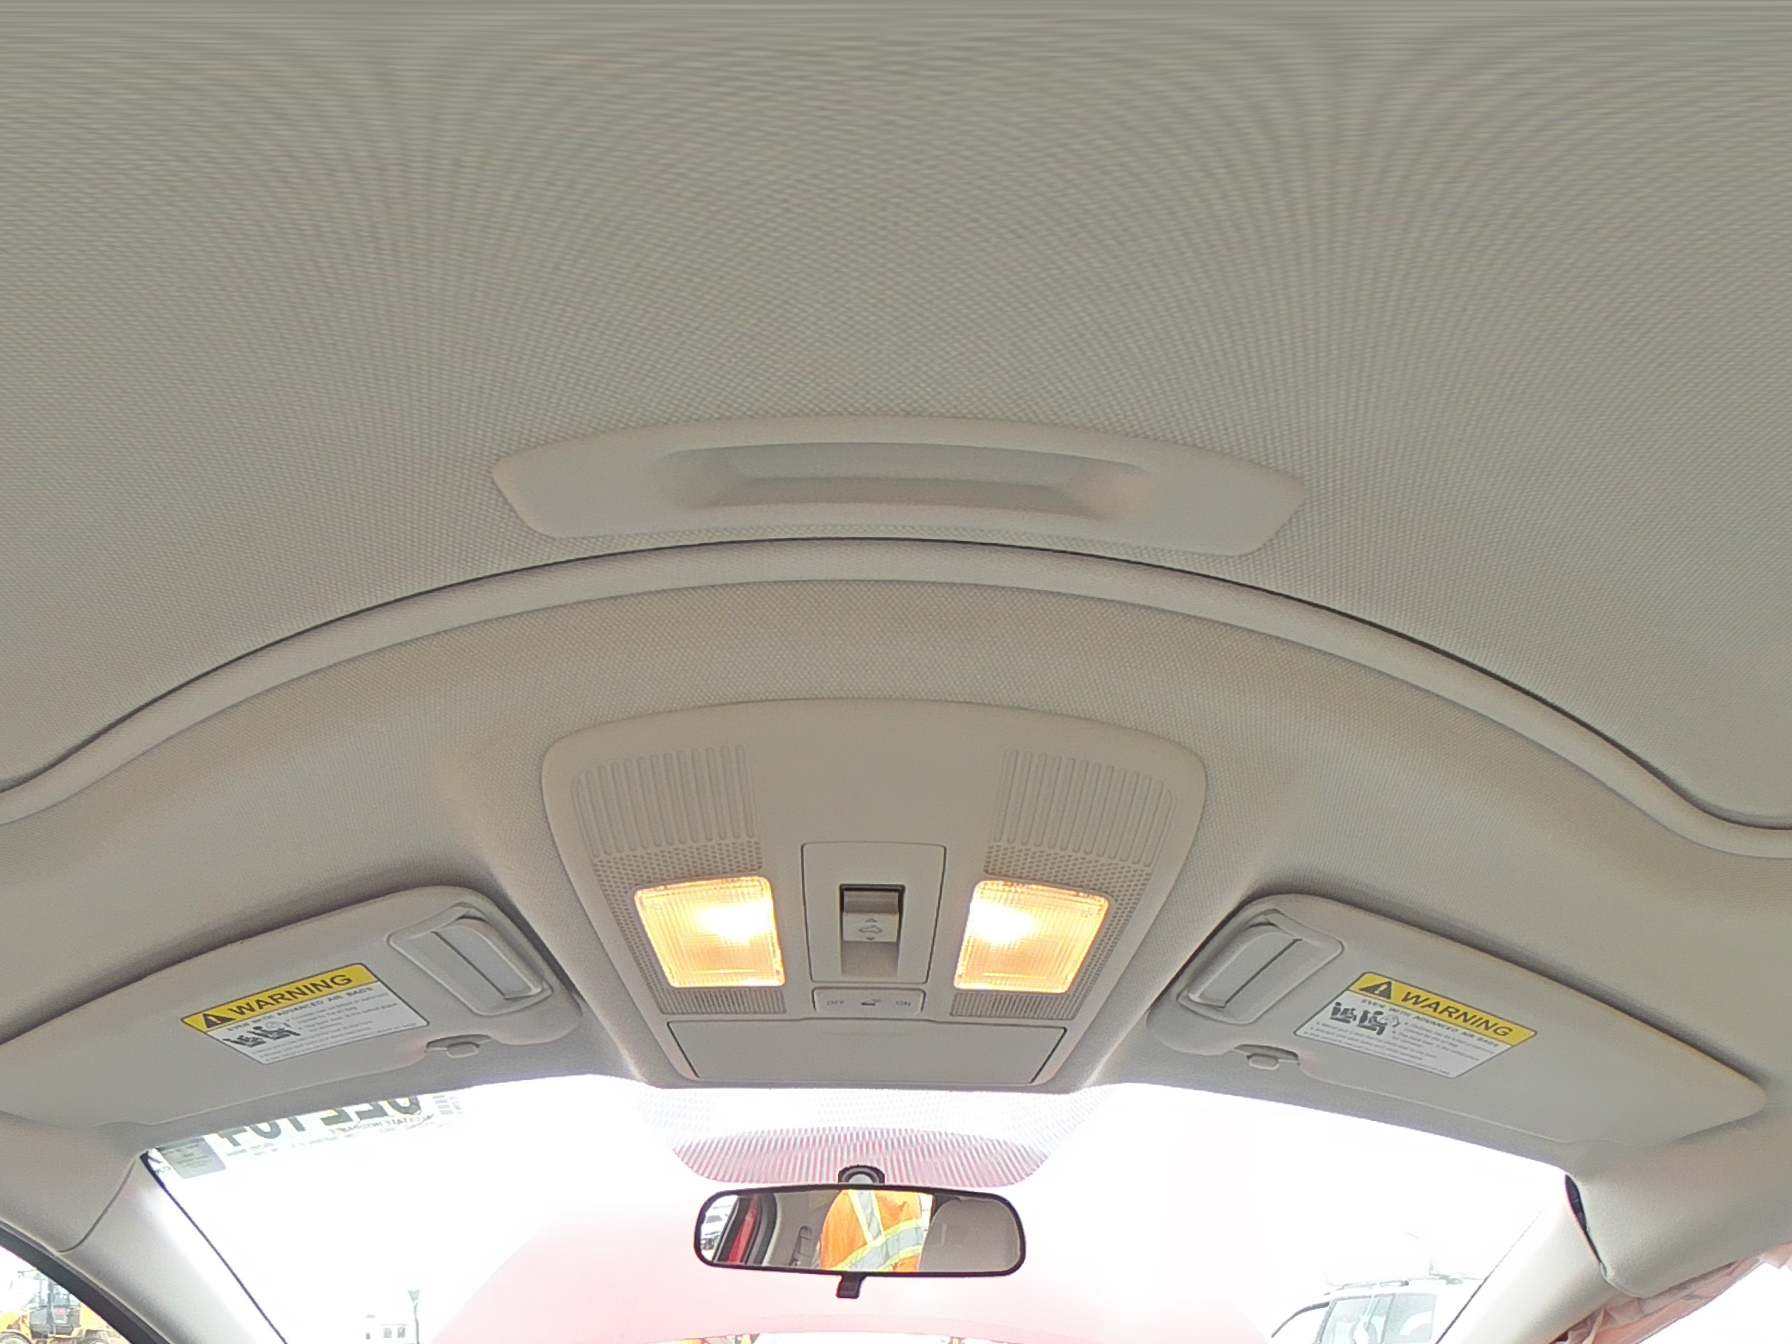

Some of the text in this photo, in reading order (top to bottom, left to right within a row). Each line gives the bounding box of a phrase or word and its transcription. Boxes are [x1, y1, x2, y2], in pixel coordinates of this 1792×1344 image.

[227, 974, 353, 1016] WARNING
[277, 1000, 324, 1016] ADVANCED
[345, 986, 374, 997] BAGS
[1400, 991, 1514, 1037] WARNING
[1414, 1015, 1459, 1033] ADVANCED
[1460, 1030, 1475, 1039] AIR
